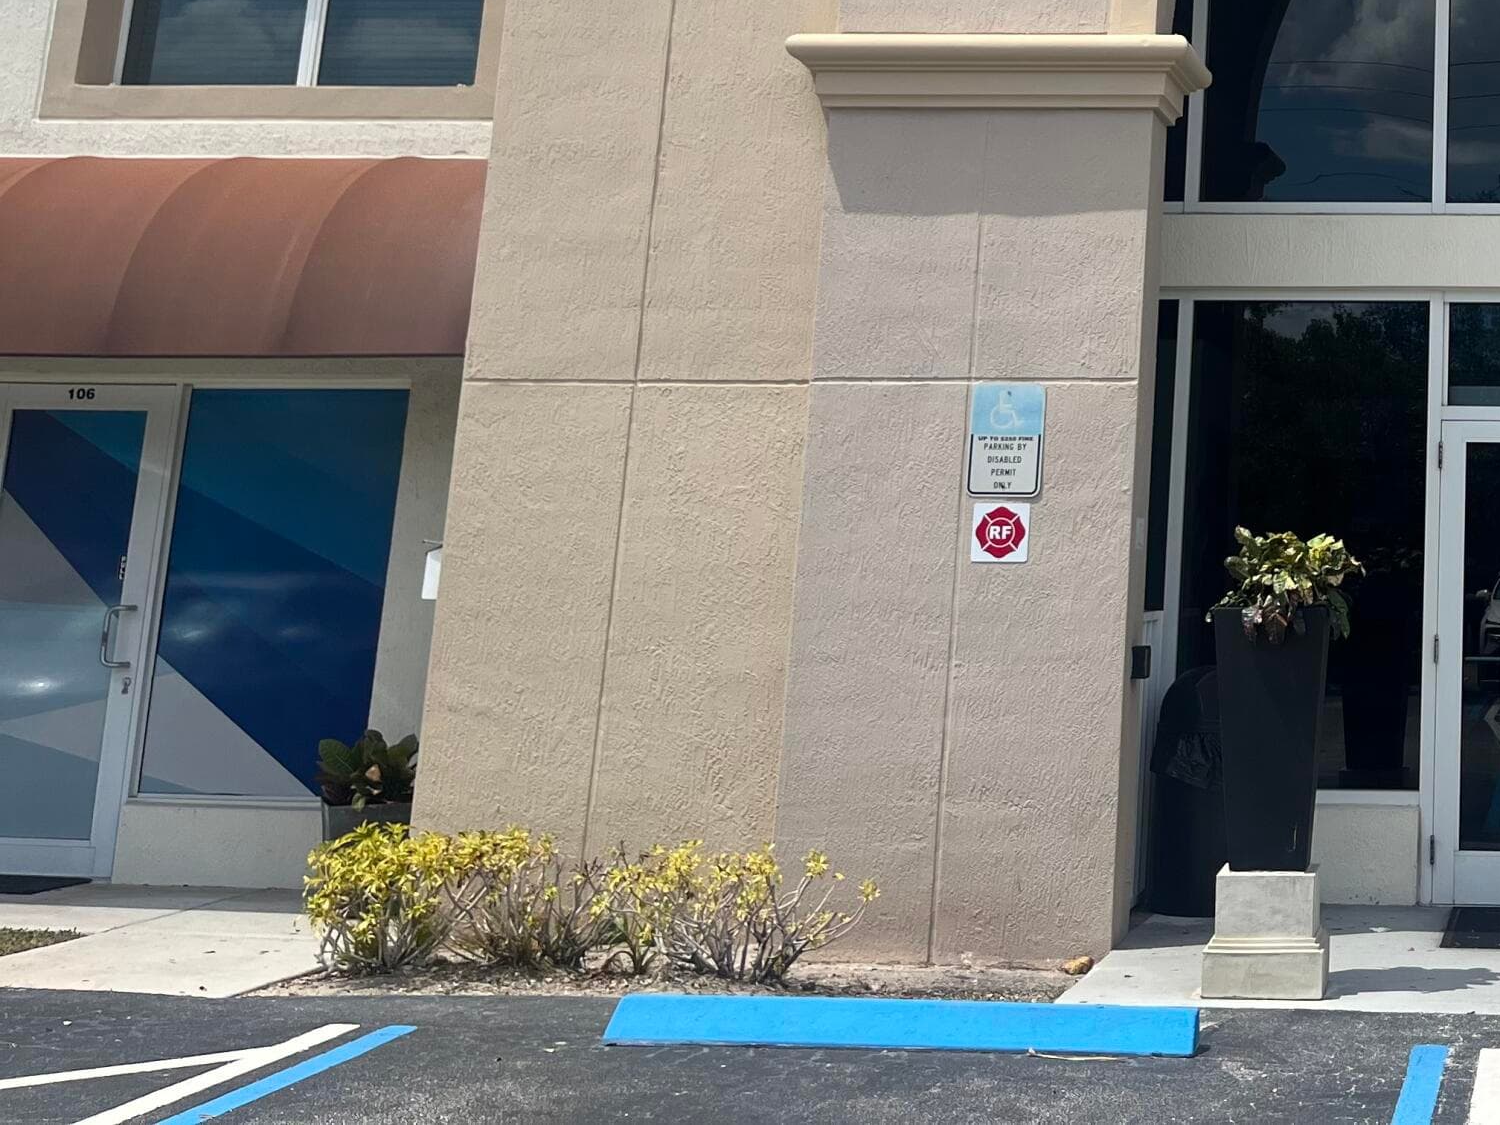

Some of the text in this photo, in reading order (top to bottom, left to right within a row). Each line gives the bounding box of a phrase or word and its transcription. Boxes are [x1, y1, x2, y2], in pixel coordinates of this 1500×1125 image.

[68, 388, 96, 400] 106
[983, 443, 1027, 451] PARKING BY
[987, 456, 1022, 464] DISABLED
[990, 468, 1016, 476] PERMIT
[993, 481, 1012, 489] ONLY
[989, 525, 1012, 539] RF
